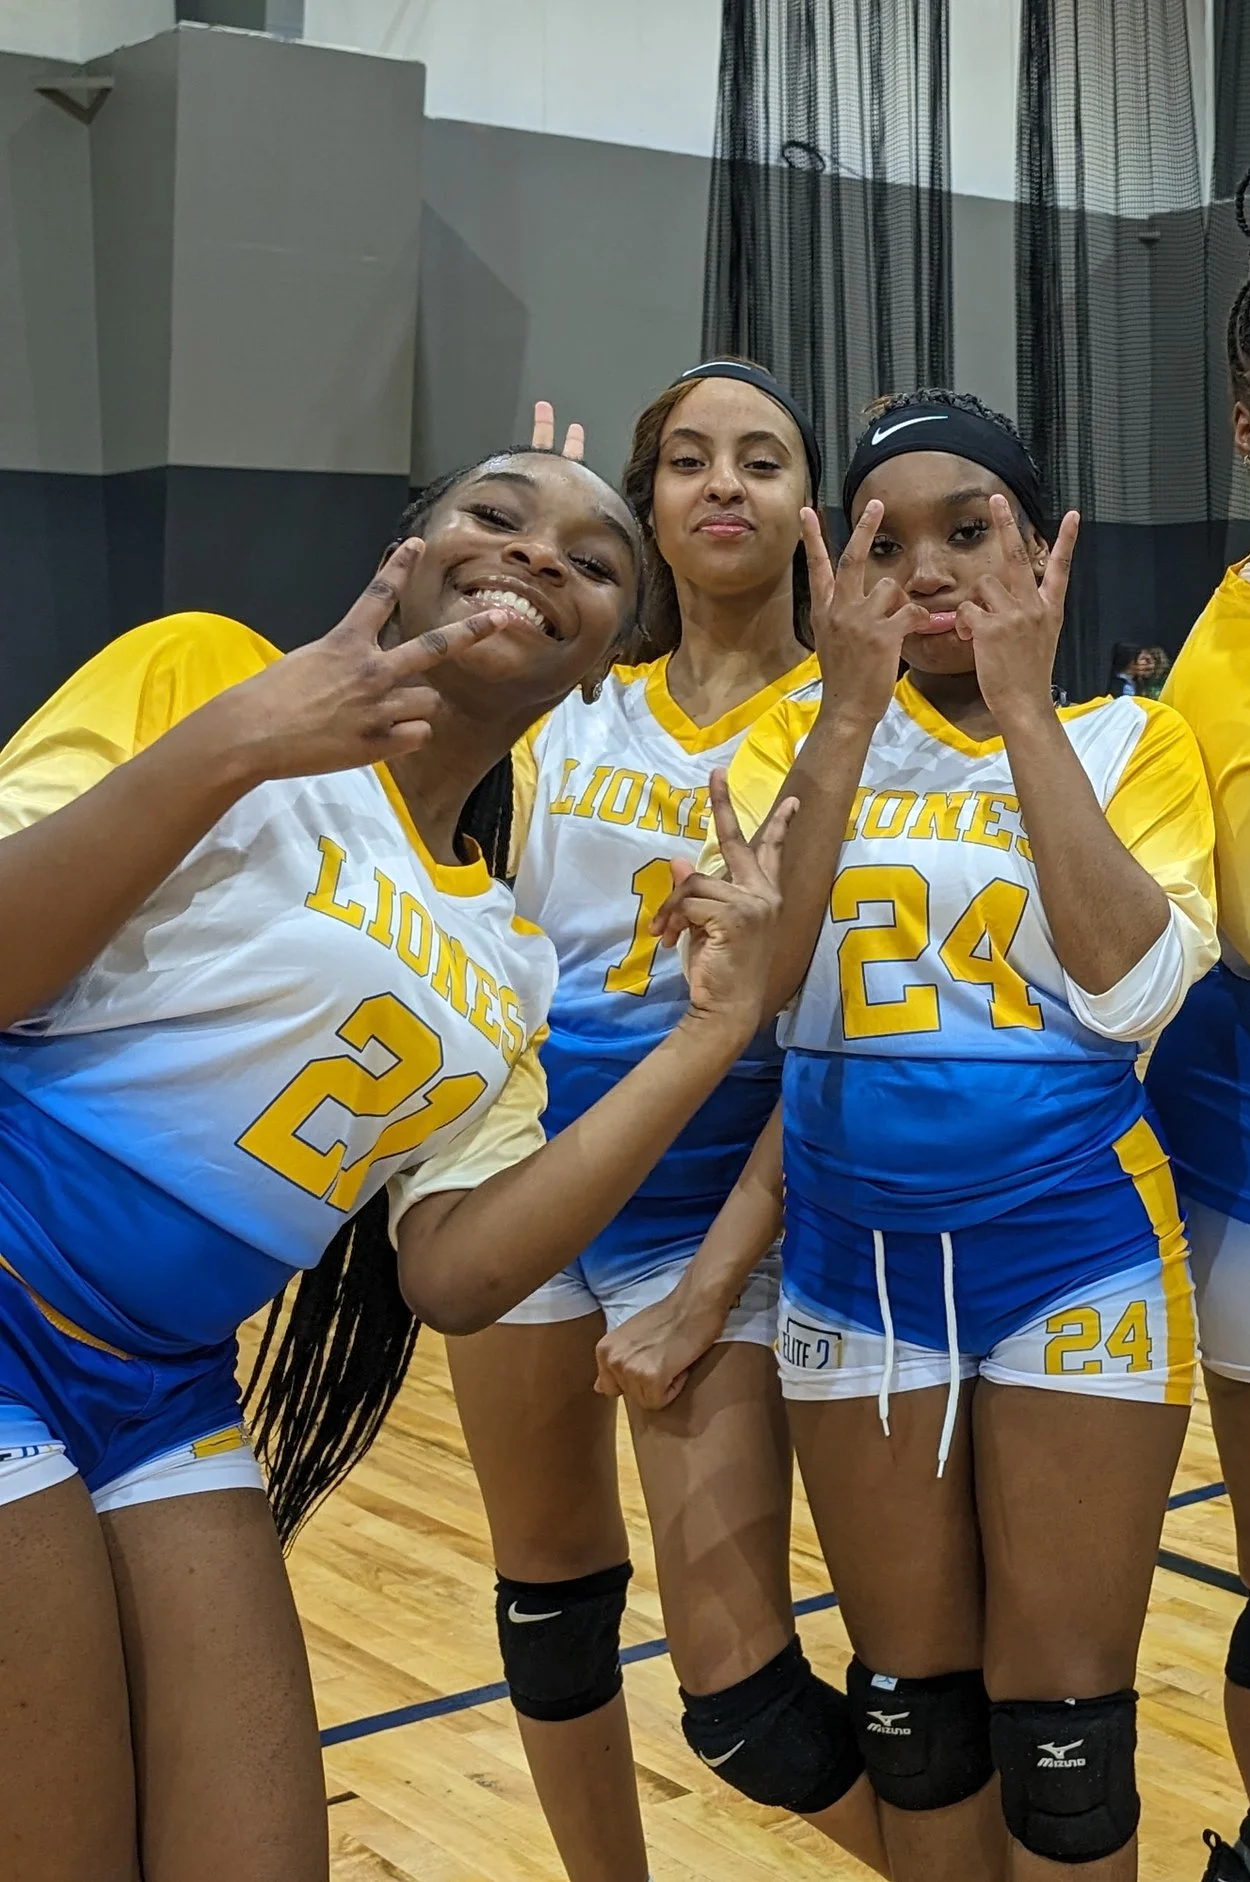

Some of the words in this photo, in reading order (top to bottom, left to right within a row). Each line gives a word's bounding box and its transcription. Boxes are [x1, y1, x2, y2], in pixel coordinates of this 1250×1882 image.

[602, 857, 675, 997] 1
[829, 863, 1046, 1041] 24
[234, 991, 488, 1214] 21
[783, 1331, 811, 1368] ELITE
[1044, 1300, 1153, 1375] 24
[867, 1722, 911, 1735] MIZUNO
[1037, 1757, 1086, 1768] MIZUNO
